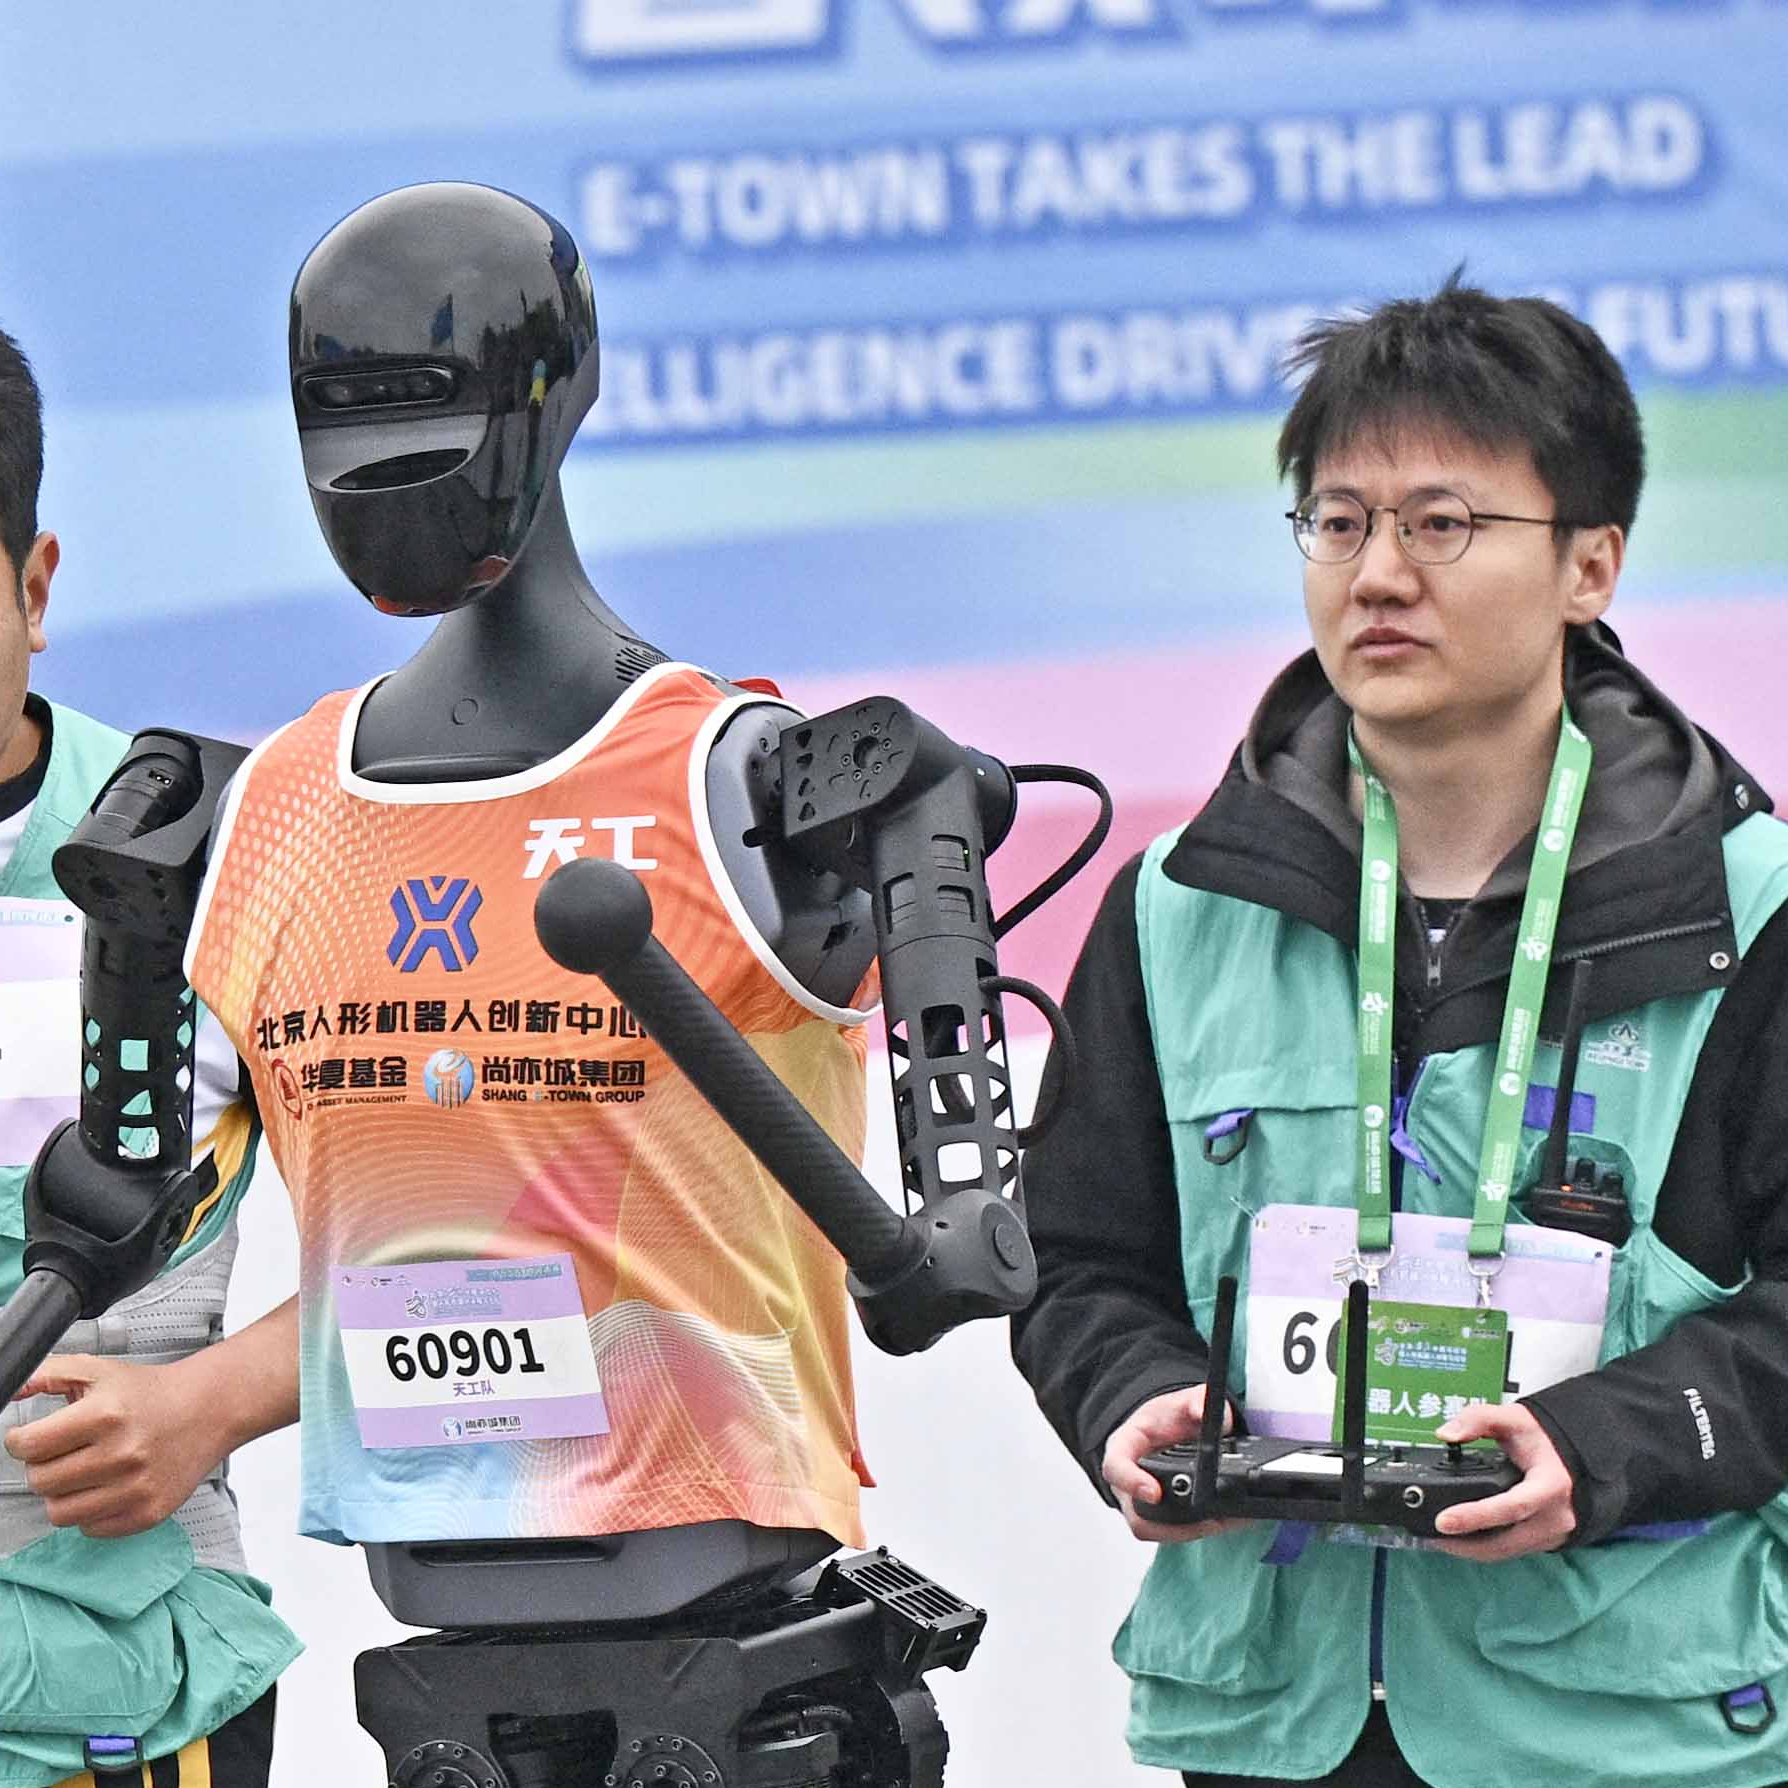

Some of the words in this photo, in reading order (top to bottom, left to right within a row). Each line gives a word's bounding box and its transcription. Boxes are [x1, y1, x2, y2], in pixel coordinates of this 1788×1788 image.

[583, 147, 947, 255] E-TOWN
[960, 122, 1253, 225] TAKES
[1265, 109, 1442, 205] THE
[1453, 94, 1704, 196] LEAD
[257, 999, 646, 1051] 北京人形机器人创新中心
[301, 1056, 407, 1093] 华夏基金
[482, 1056, 645, 1087] 尚亦城集团
[482, 1089, 527, 1102] SHANG
[595, 1091, 645, 1104] GROUP
[386, 1327, 545, 1382] 60901
[453, 1379, 496, 1397] 天工队
